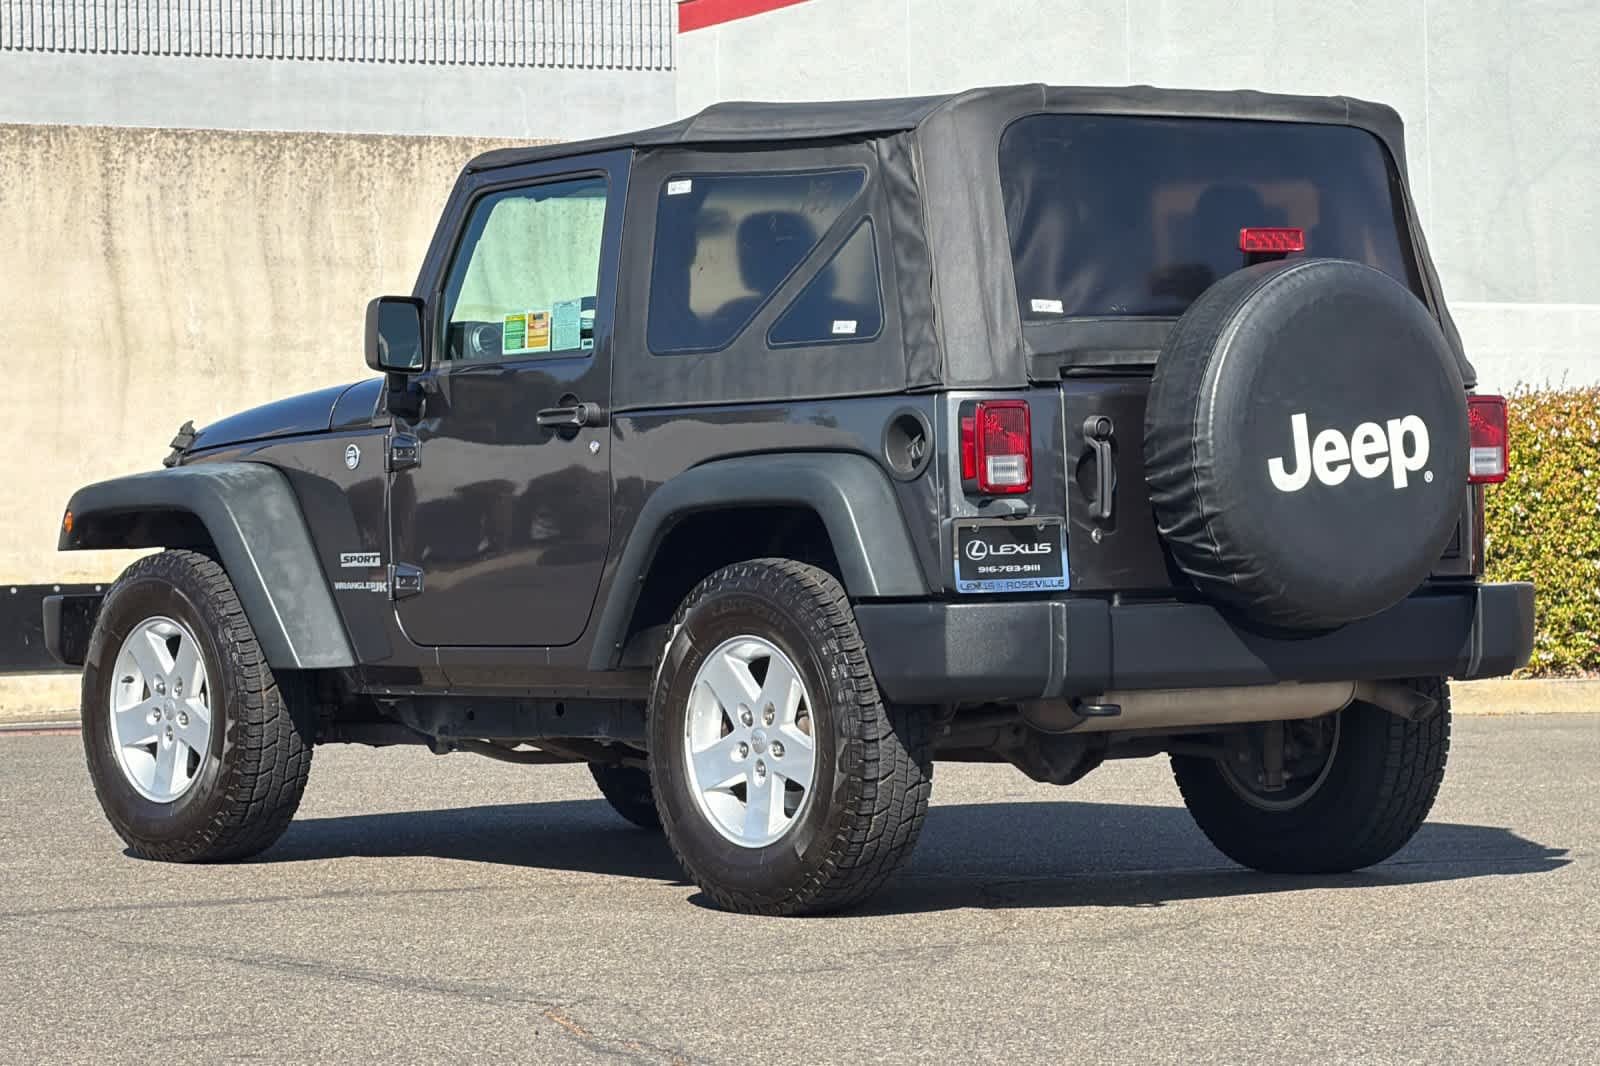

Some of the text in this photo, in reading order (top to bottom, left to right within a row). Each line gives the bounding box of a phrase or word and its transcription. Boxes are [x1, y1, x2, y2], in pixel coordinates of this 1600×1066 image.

[989, 543, 1052, 555] LEXUS
[340, 555, 381, 564] SPORT
[978, 564, 1041, 573] 916-783-9111
[960, 582, 996, 591] LEXUS
[1006, 579, 1065, 589] ROSEVILLE
